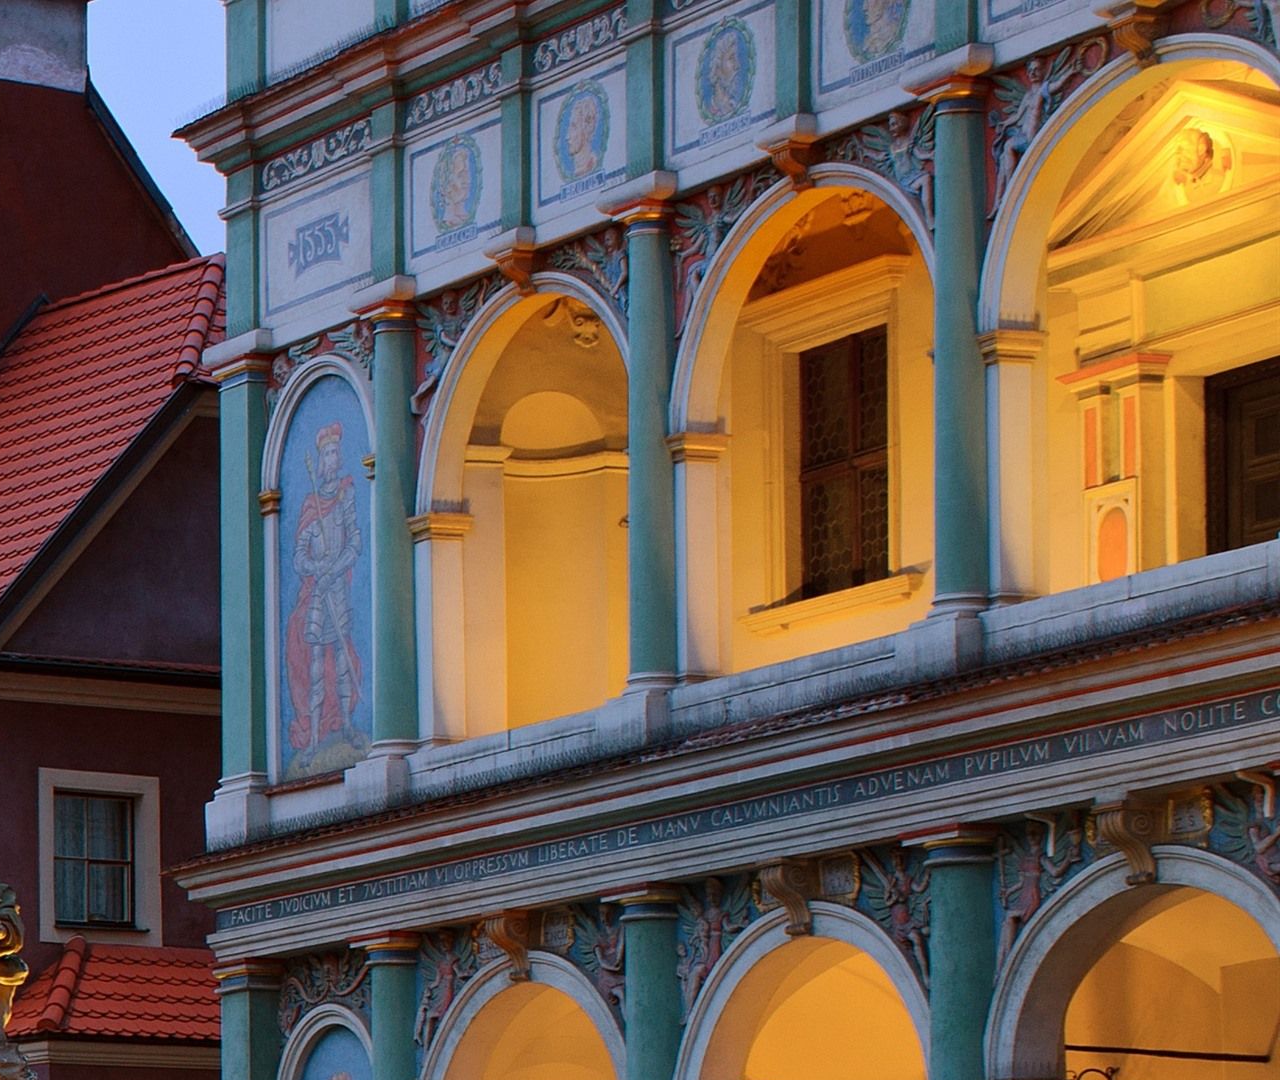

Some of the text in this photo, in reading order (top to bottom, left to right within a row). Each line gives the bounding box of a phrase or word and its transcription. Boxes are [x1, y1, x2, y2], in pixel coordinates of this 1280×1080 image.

[298, 218, 337, 266] 1555
[231, 903, 272, 925] FACITE
[339, 886, 356, 903] ET
[435, 867, 448, 882] VI
[455, 852, 529, 879] OPPRESSVM
[539, 833, 608, 863] LIBERATE
[617, 827, 639, 847] DE
[651, 815, 700, 840] MANV
[711, 784, 841, 827] CALVMNIANTIS
[854, 766, 949, 798] ADVENAM
[964, 742, 1050, 776] PVPILVM
[1163, 700, 1246, 735] NOLITE
